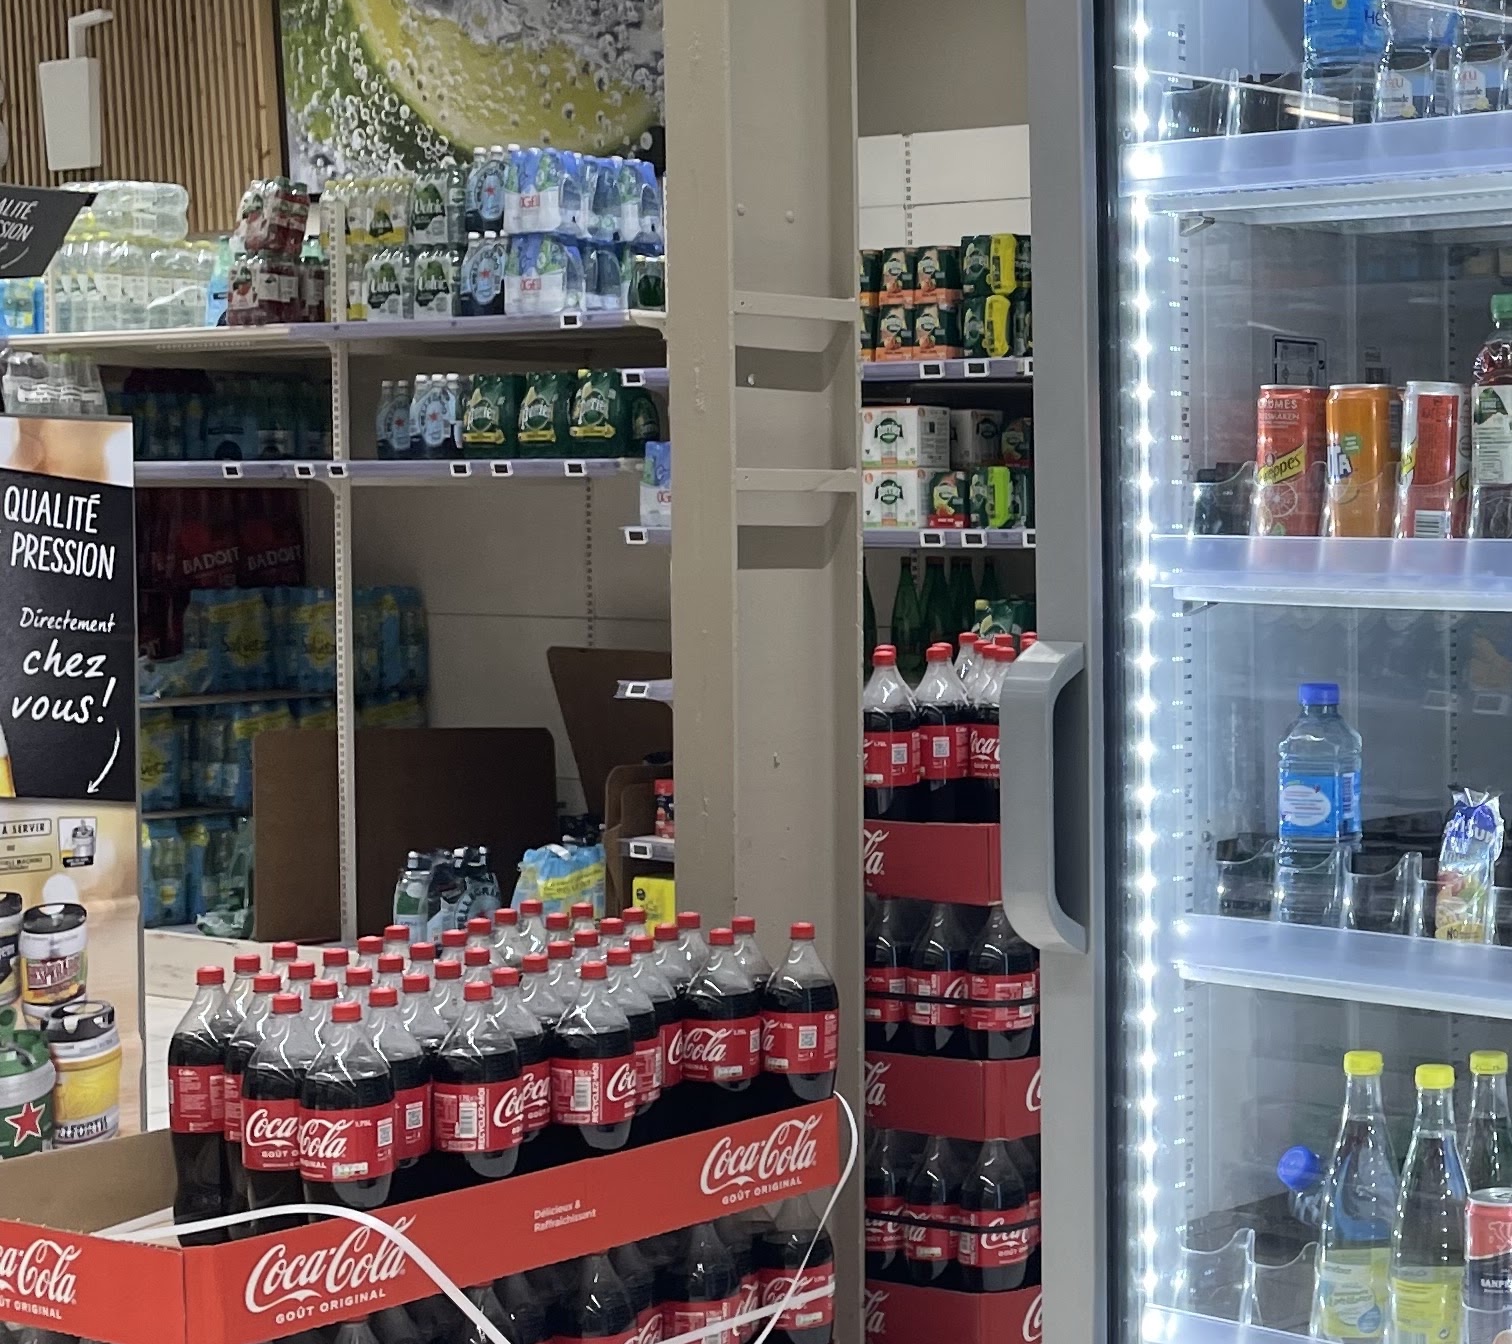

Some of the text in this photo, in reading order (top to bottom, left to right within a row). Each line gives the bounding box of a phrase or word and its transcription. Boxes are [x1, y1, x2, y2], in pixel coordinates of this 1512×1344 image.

[3, 486, 101, 534] QUALITÉ
[10, 531, 116, 580] PRESSION
[19, 606, 116, 633] Directement
[22, 638, 108, 678] chez
[10, 677, 117, 724] vous!
[722, 1176, 803, 1205] GOÛT ORIGINAL
[14, 1300, 63, 1321] ORIGINAL
[275, 1288, 387, 1325] GOÛT ORIGINAL
